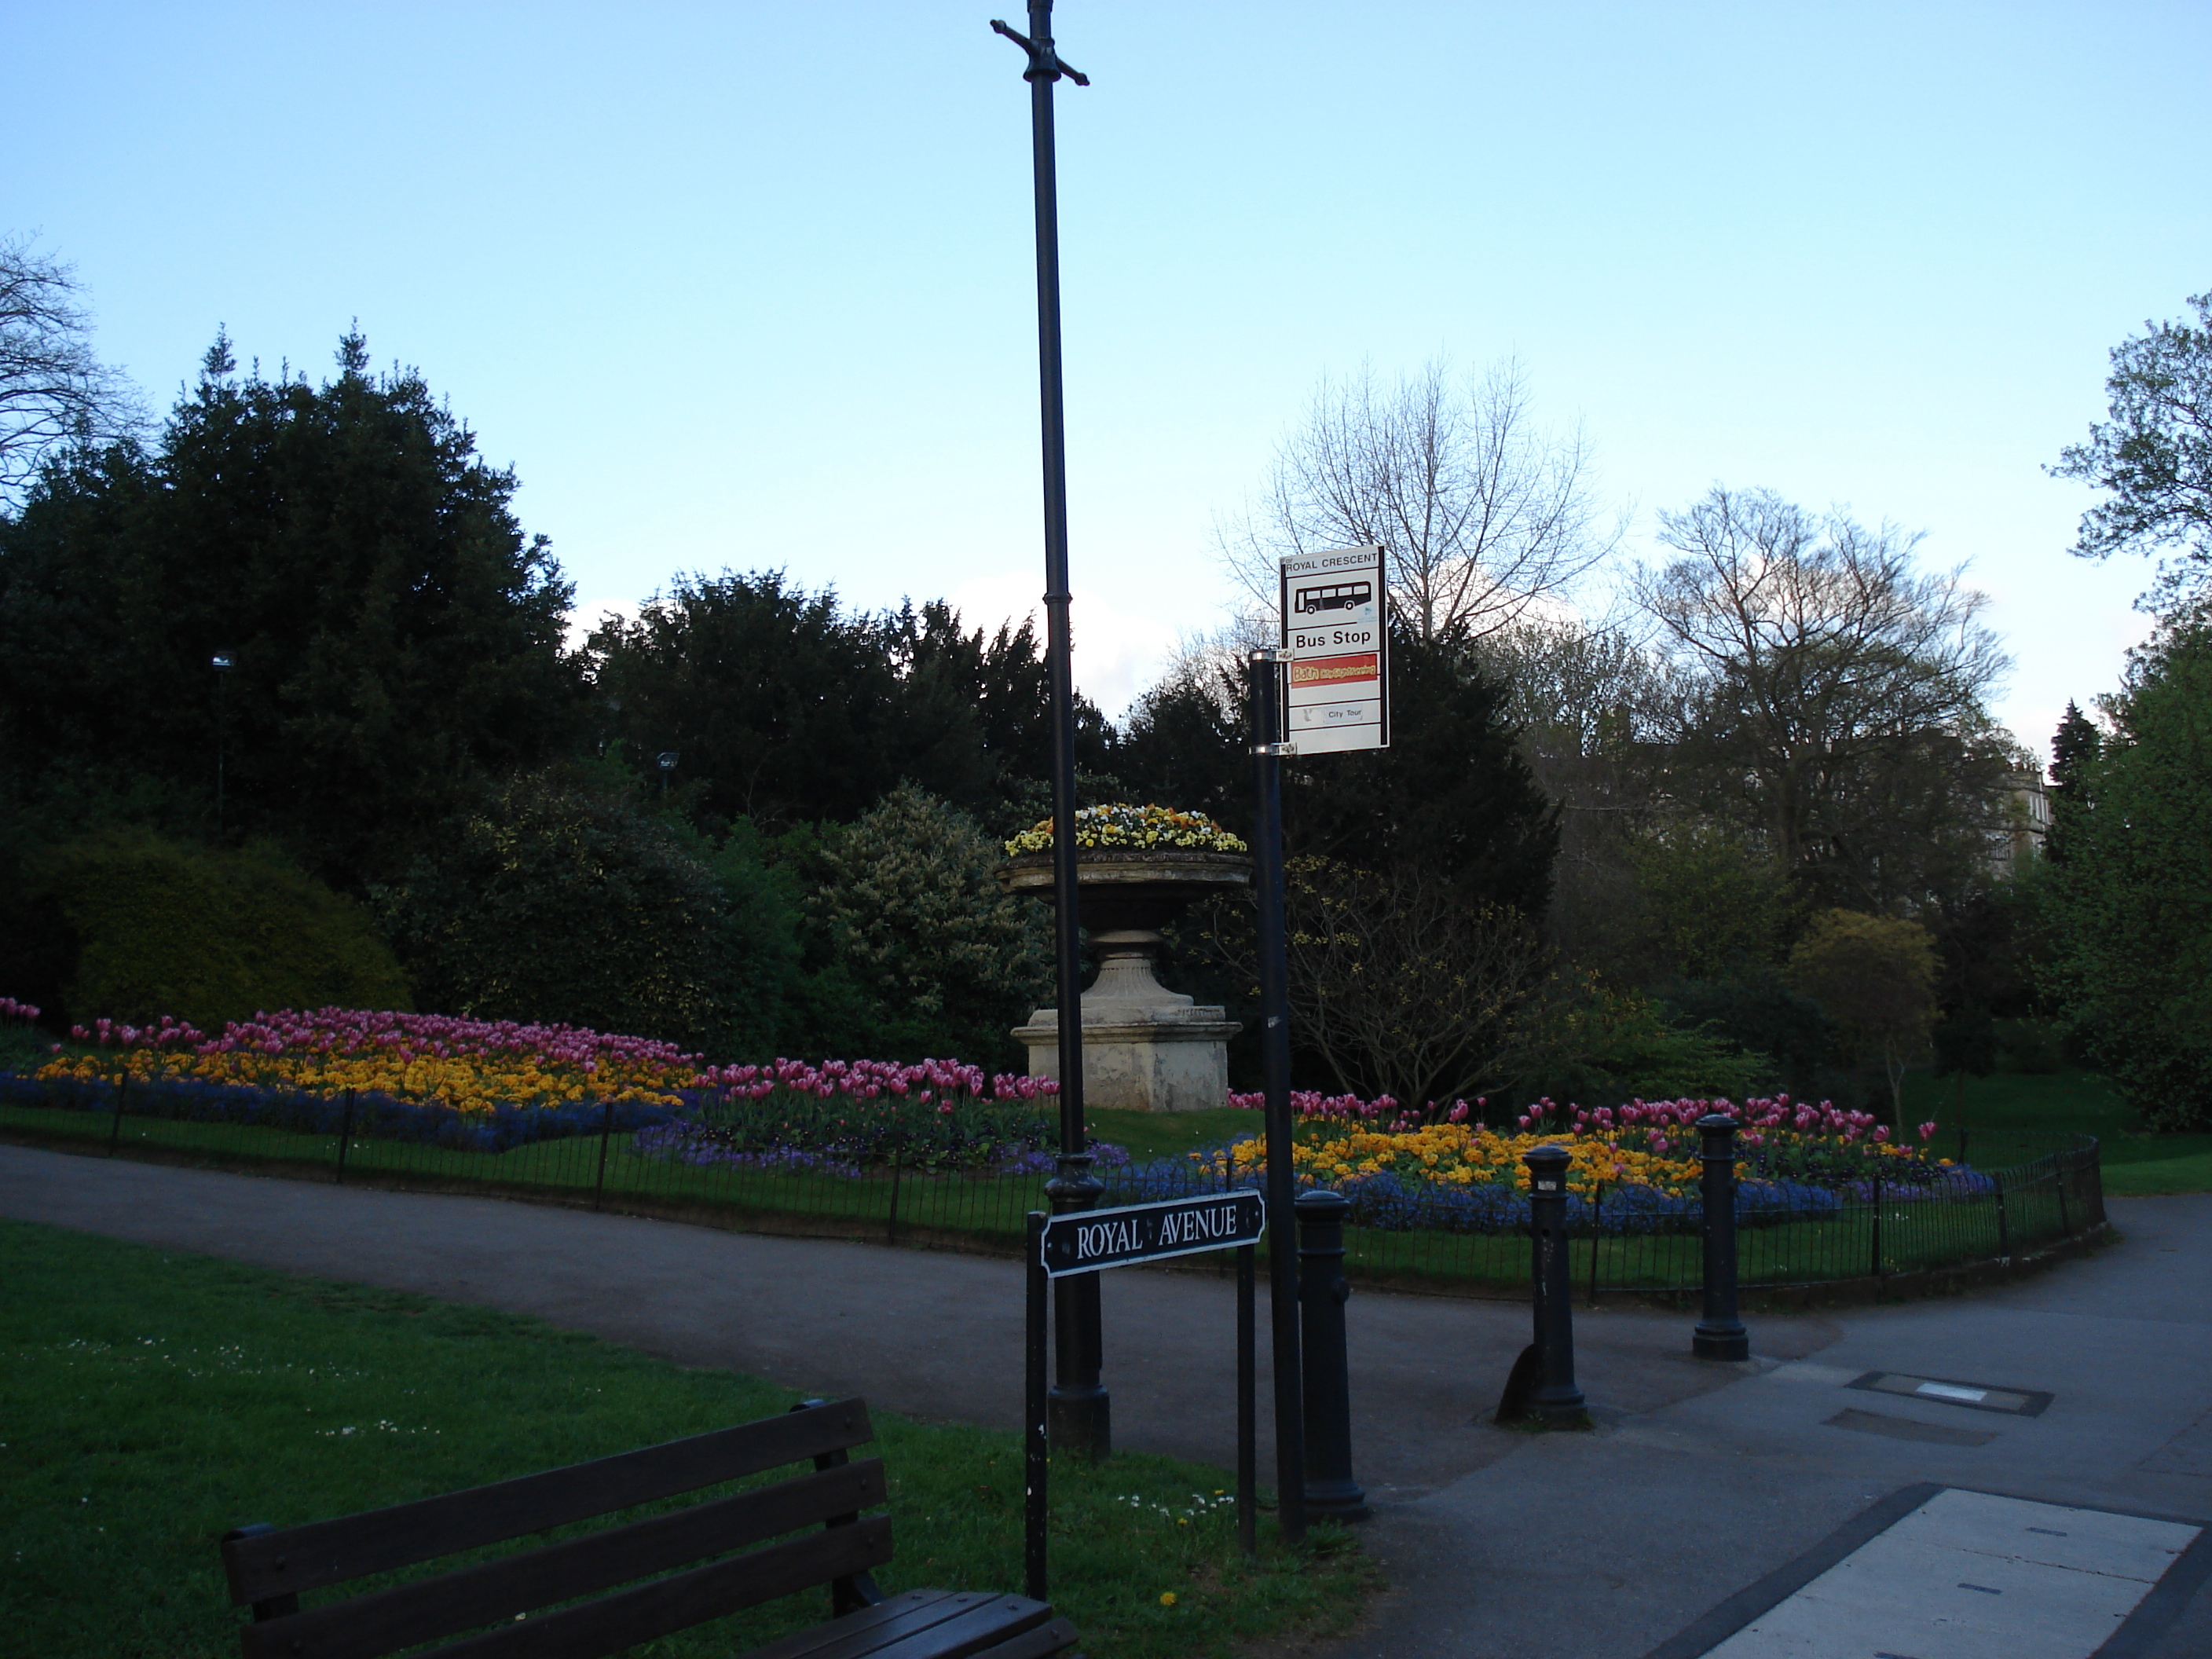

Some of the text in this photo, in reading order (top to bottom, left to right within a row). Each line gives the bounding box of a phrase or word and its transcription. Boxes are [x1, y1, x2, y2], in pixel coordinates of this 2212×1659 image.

[1286, 553, 1378, 572] ROYAL CRESCENT
[1296, 631, 1371, 648] Bus Stop
[1293, 666, 1319, 682] Bath
[1077, 1205, 1237, 1259] ROYAL AVENUE
